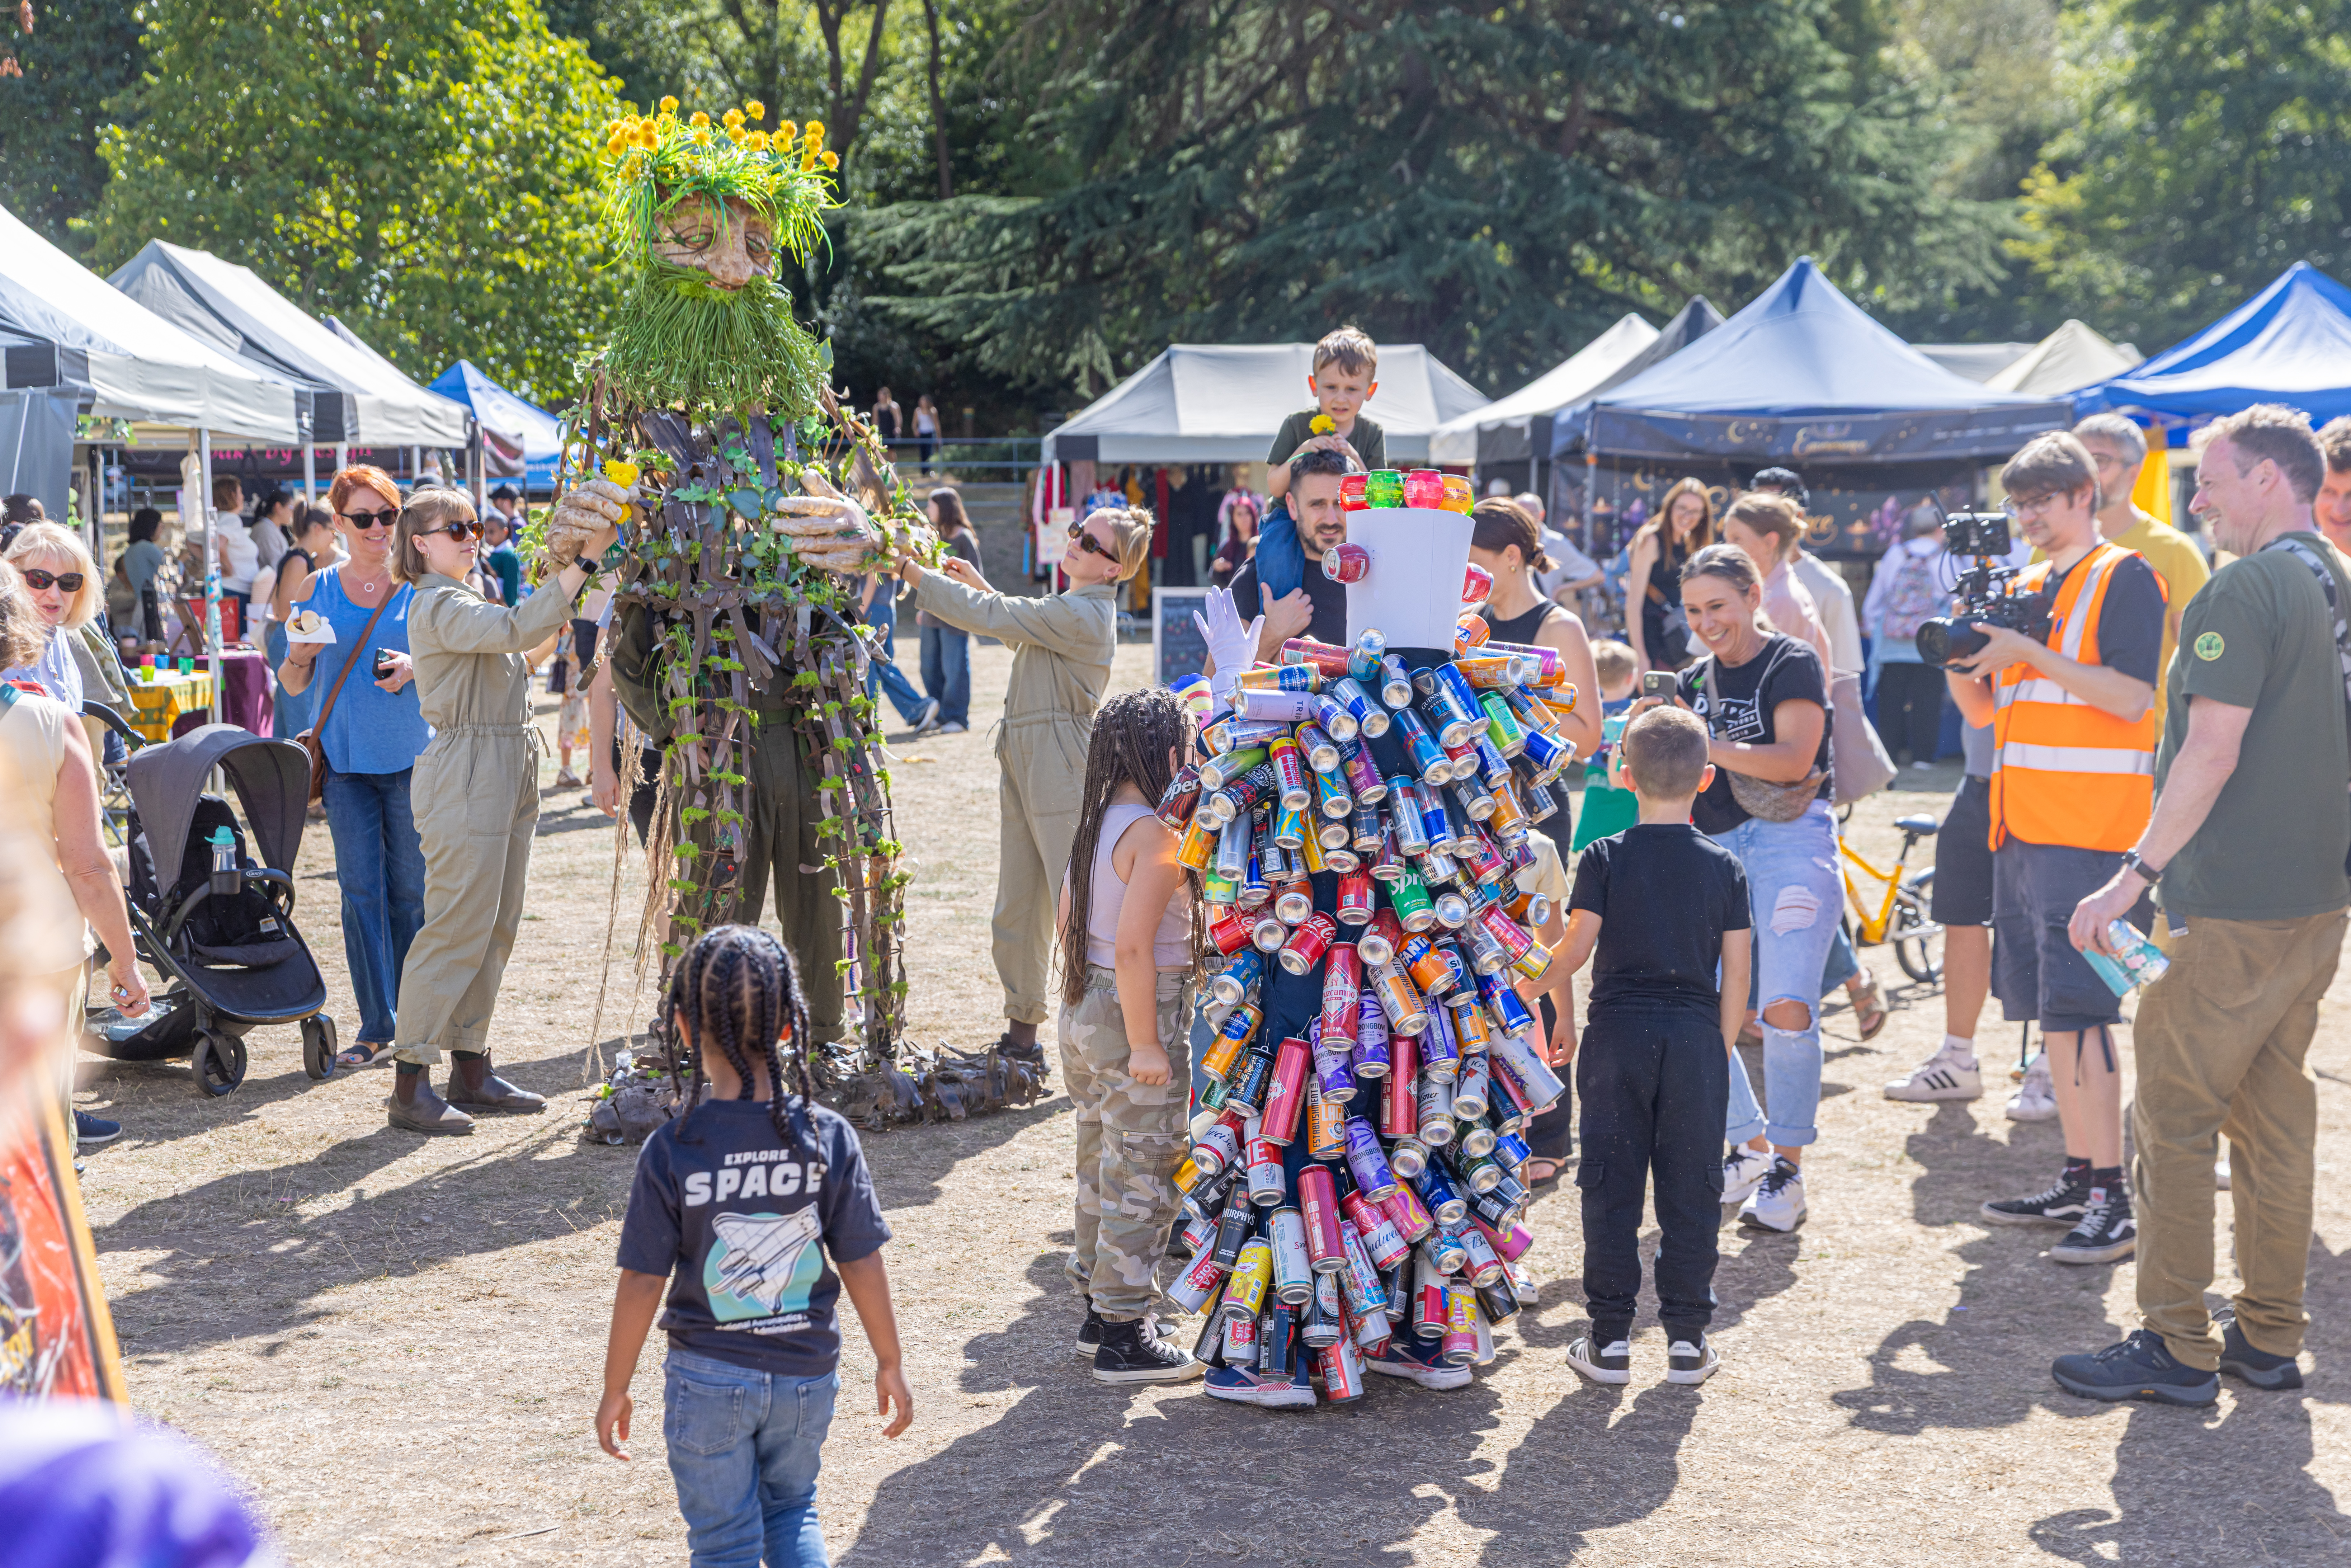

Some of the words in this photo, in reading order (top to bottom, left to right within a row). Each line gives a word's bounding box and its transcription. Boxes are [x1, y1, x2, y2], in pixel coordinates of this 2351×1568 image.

[1421, 691, 1450, 710] GUINNESS
[1428, 697, 1448, 711] DRAUGHT
[1294, 700, 1303, 720] TRIP
[1433, 701, 1451, 716] 0.0
[1407, 726, 1425, 739] Bull
[1343, 750, 1356, 761] ARANCIA
[1261, 764, 1277, 790] DANIEL'S
[1289, 756, 1302, 785] ORIGINAL
[1418, 862, 1431, 871] This
[1423, 873, 1438, 883] taste
[1480, 910, 1489, 919] RIGINAL
[1238, 926, 1247, 938] TASTE
[1303, 928, 1320, 940] ORIGINAL
[1399, 936, 1430, 966] FANTA
[1372, 971, 1383, 982] LAGER
[1393, 963, 1423, 1009] ESTABLISHMENT
[1480, 983, 1495, 997] Red
[1223, 1026, 1238, 1035] ARANCIATA
[1358, 1023, 1385, 1031] RONGBOW
[1498, 1060, 1521, 1088] STELLA
[1311, 1089, 1321, 1148] ESTABLISHMENT
[725, 1149, 789, 1166] EXPLORE
[1350, 1147, 1381, 1164] STRONGBOW
[685, 1162, 826, 1206] SPACE
[1221, 1208, 1255, 1226] MURPHY'S
[1193, 1247, 1209, 1266] BELGIUM
[752, 1313, 802, 1326] Aeronautics
[753, 1322, 812, 1335] Administration
